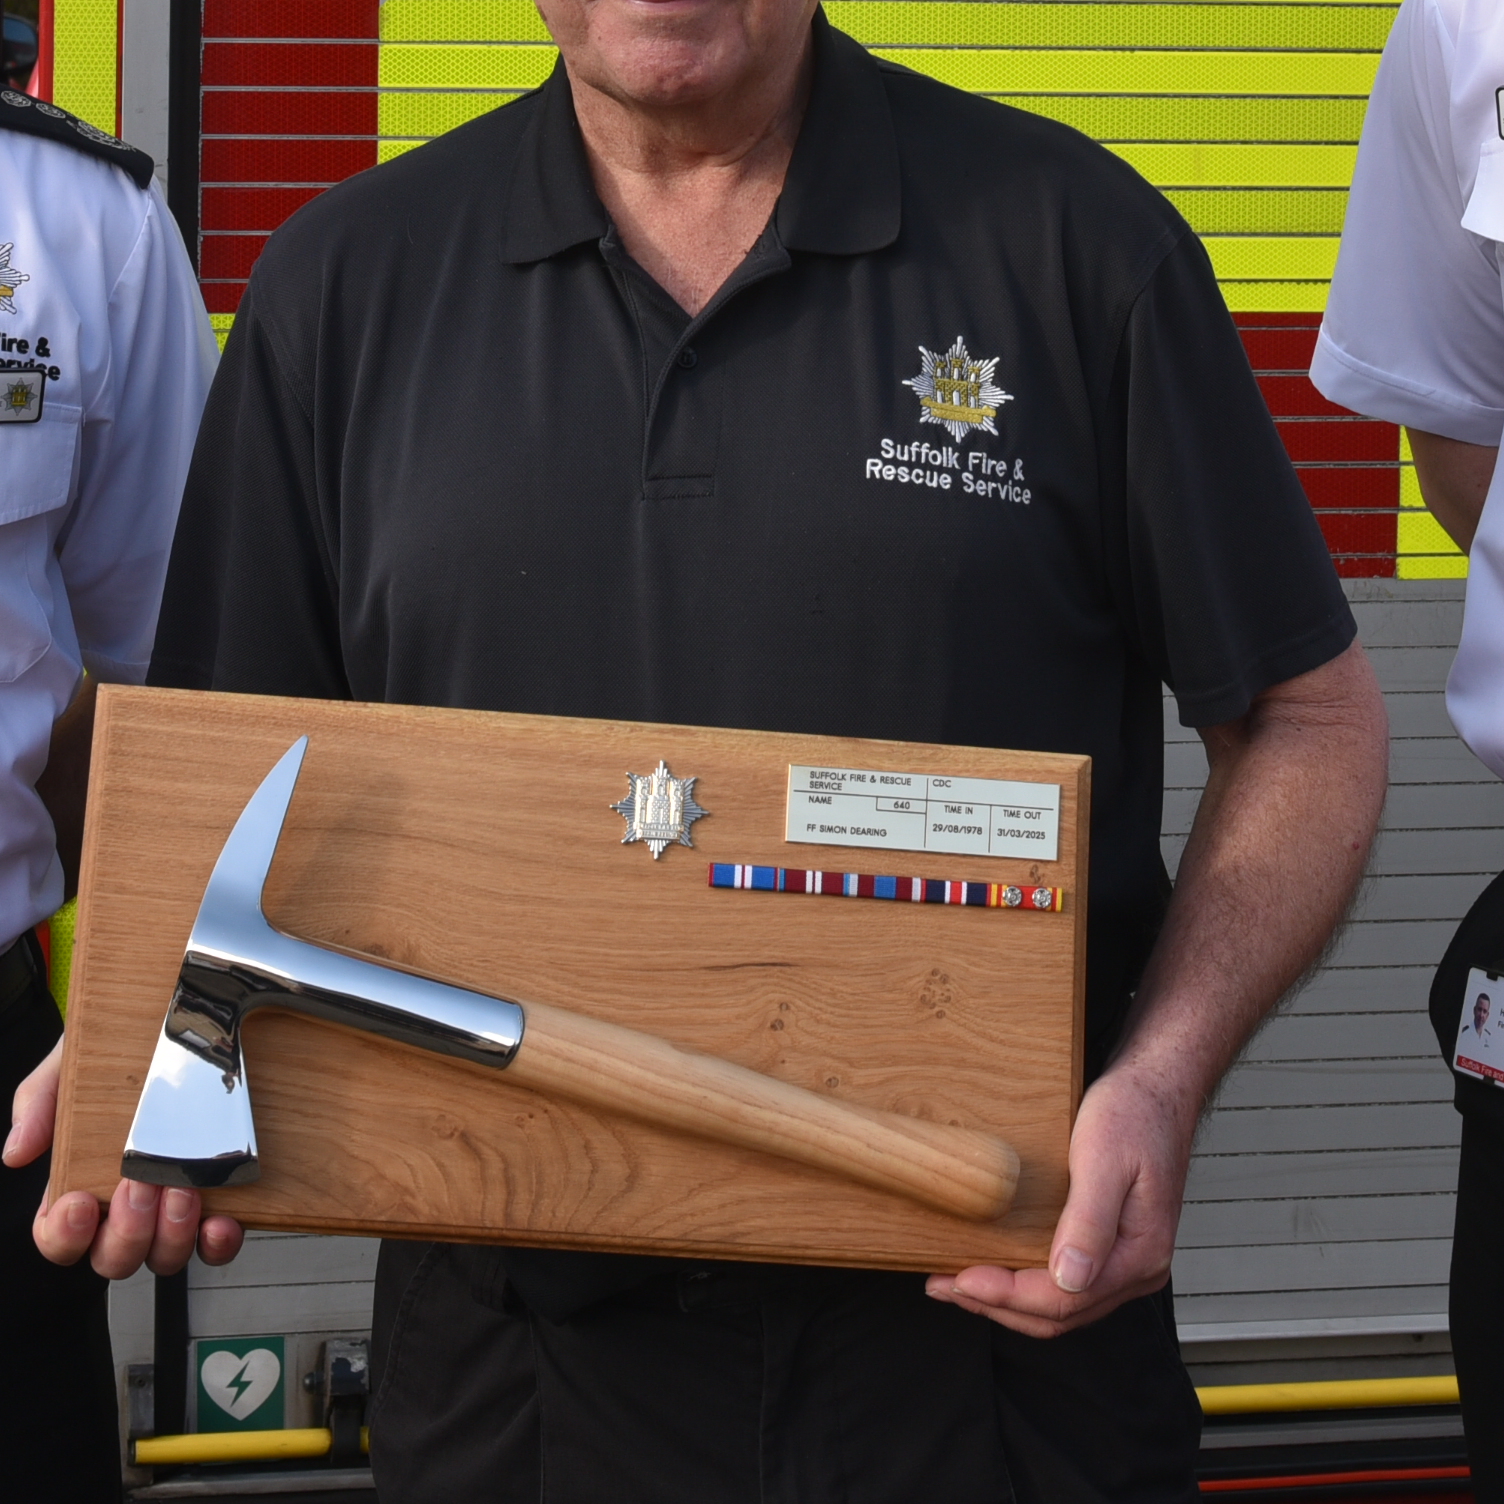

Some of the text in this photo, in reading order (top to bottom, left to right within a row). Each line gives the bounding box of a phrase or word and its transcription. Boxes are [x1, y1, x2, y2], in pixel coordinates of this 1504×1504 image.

[35, 337, 52, 357] &
[880, 438, 1025, 481] Suffolk Fire &
[866, 458, 1032, 505] Rescue Service
[809, 771, 912, 786] SUFFOLK FIRE & RESCUE
[932, 779, 952, 788] CDC
[809, 780, 842, 791] SERVICE
[808, 795, 832, 805] NAME
[893, 801, 910, 809] 640
[944, 805, 974, 815] TIME IN
[1003, 809, 1041, 820] TIME OUT
[806, 823, 887, 837] FF SIMON DEARING
[932, 823, 983, 835] 29/08/1978
[997, 828, 1046, 840] 31/03/2025
[1461, 1058, 1480, 1072] Suffolk
[1481, 1066, 1493, 1078] Fire
[1493, 1071, 1504, 1082] and
